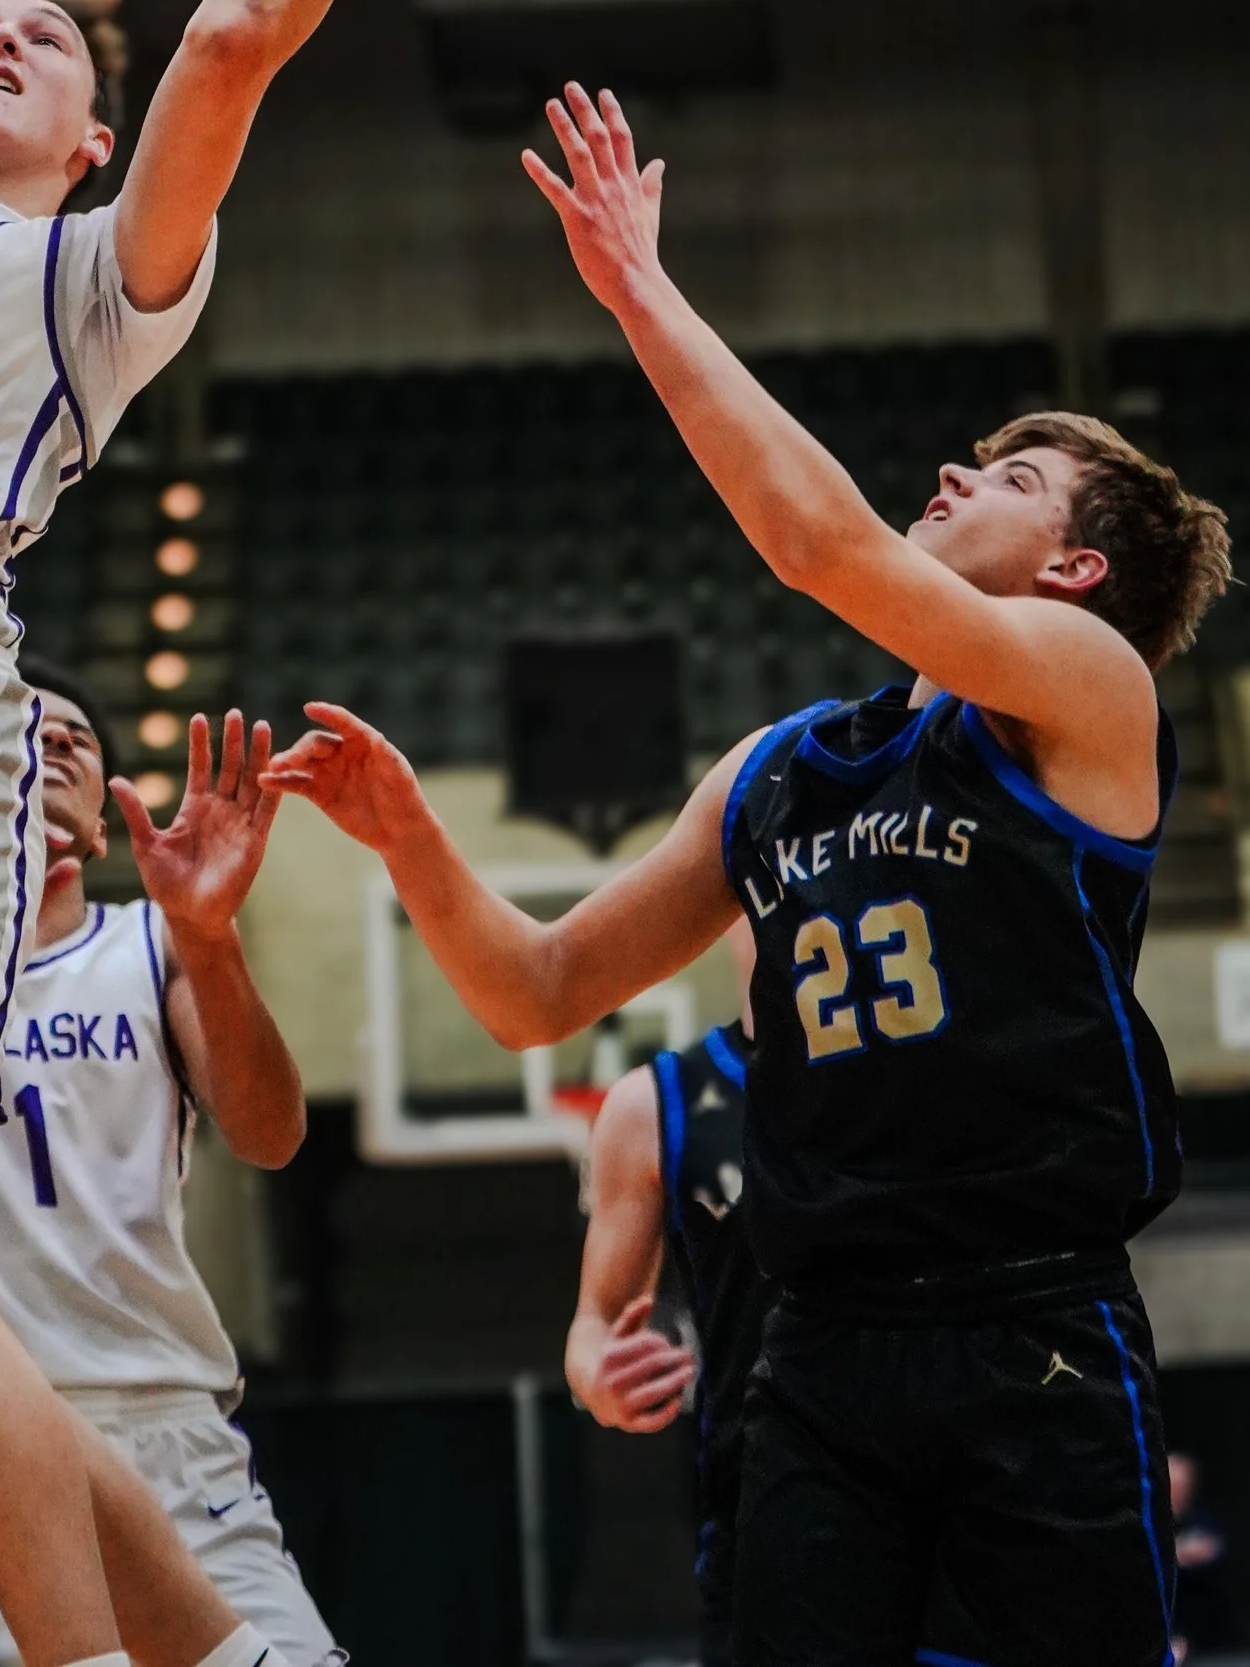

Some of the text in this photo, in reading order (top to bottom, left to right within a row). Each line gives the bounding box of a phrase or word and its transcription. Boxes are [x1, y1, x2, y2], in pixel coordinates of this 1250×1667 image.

[744, 830, 835, 919] LKE
[792, 895, 951, 1065] 23
[14, 1084, 57, 1207] 1
